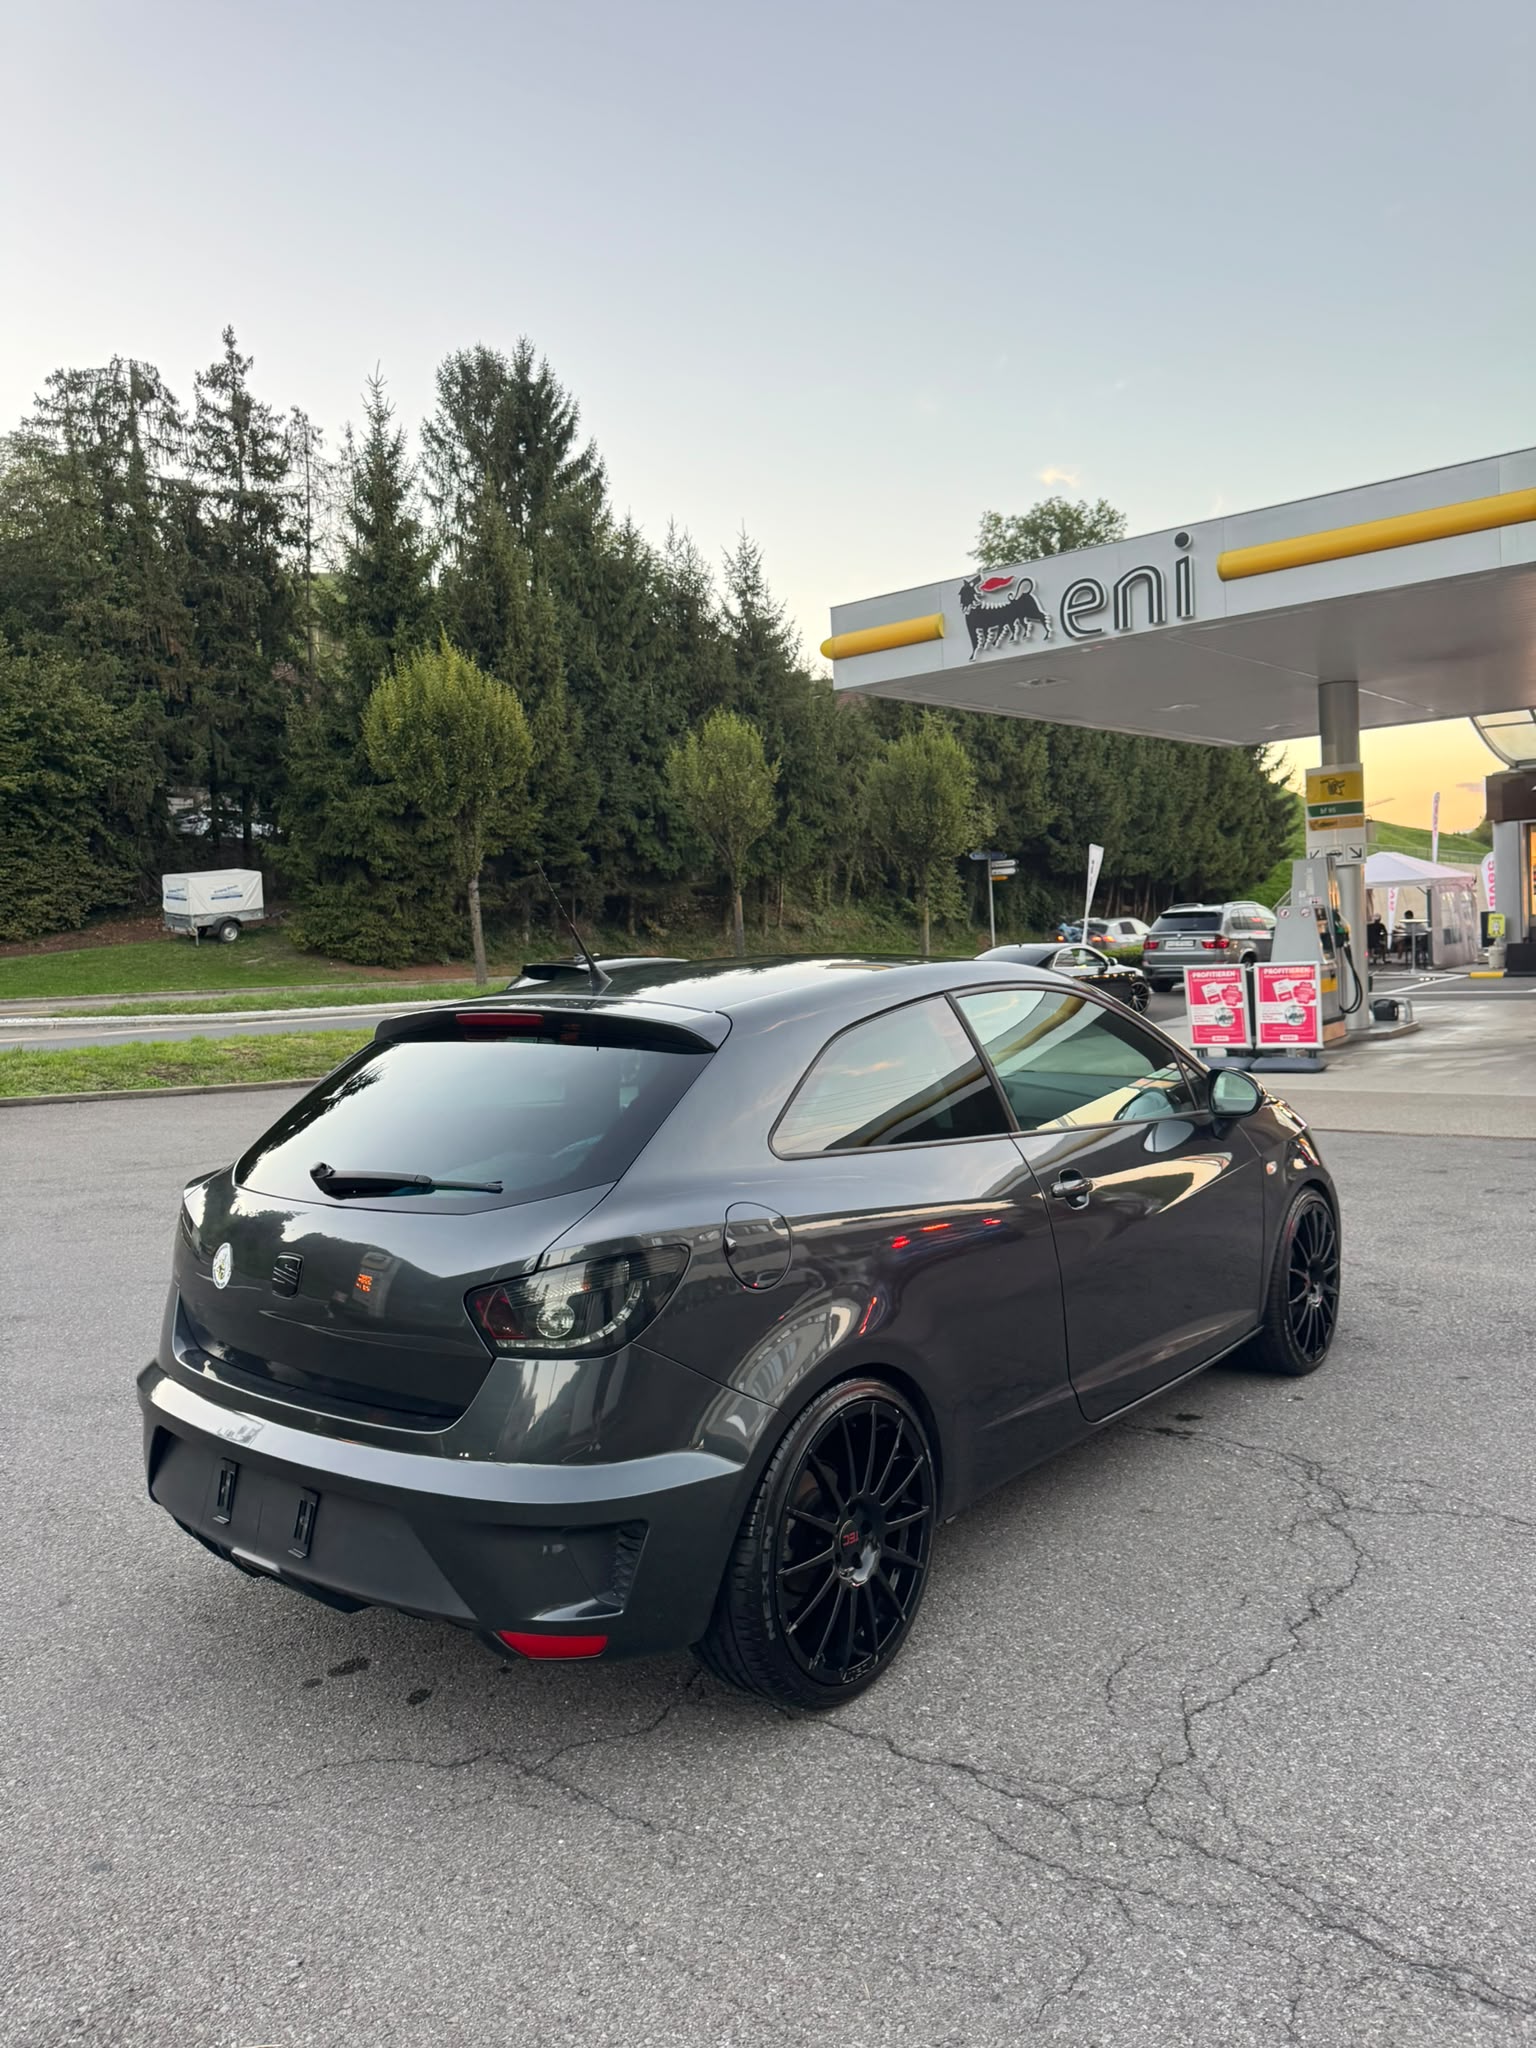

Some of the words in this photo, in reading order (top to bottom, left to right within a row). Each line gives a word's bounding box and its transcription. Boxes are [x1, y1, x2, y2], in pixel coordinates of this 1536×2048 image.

[1060, 531, 1194, 639] eni
[1191, 970, 1236, 979] PROFITIEREN
[1263, 966, 1310, 975] PROFITIEREN
